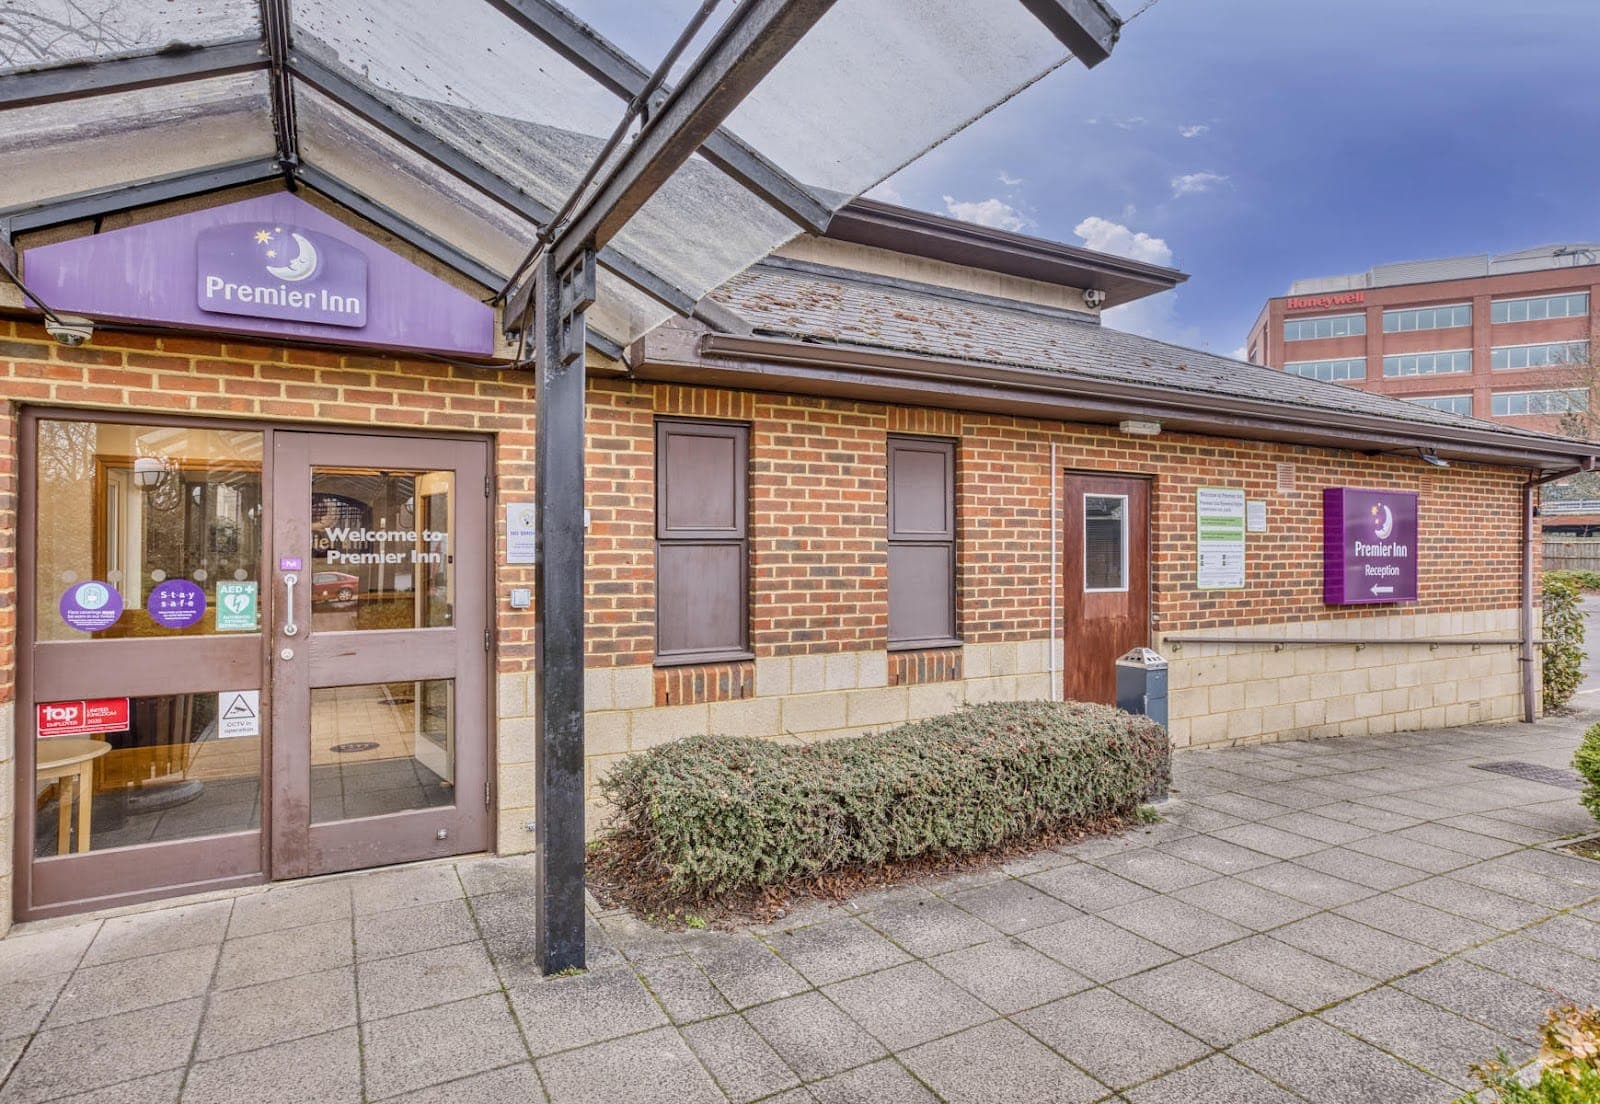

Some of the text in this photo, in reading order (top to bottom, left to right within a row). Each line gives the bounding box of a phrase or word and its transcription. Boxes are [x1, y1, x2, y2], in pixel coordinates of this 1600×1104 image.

[206, 275, 360, 314] Premier Inn
[1287, 291, 1364, 309] Honeywell
[325, 527, 417, 542] Welcome
[422, 529, 442, 541] to
[326, 549, 440, 564] Premier Inn
[1355, 540, 1408, 557] Premier Inn
[1365, 564, 1400, 579] Reception
[221, 585, 243, 593] AED
[43, 705, 79, 722] top
